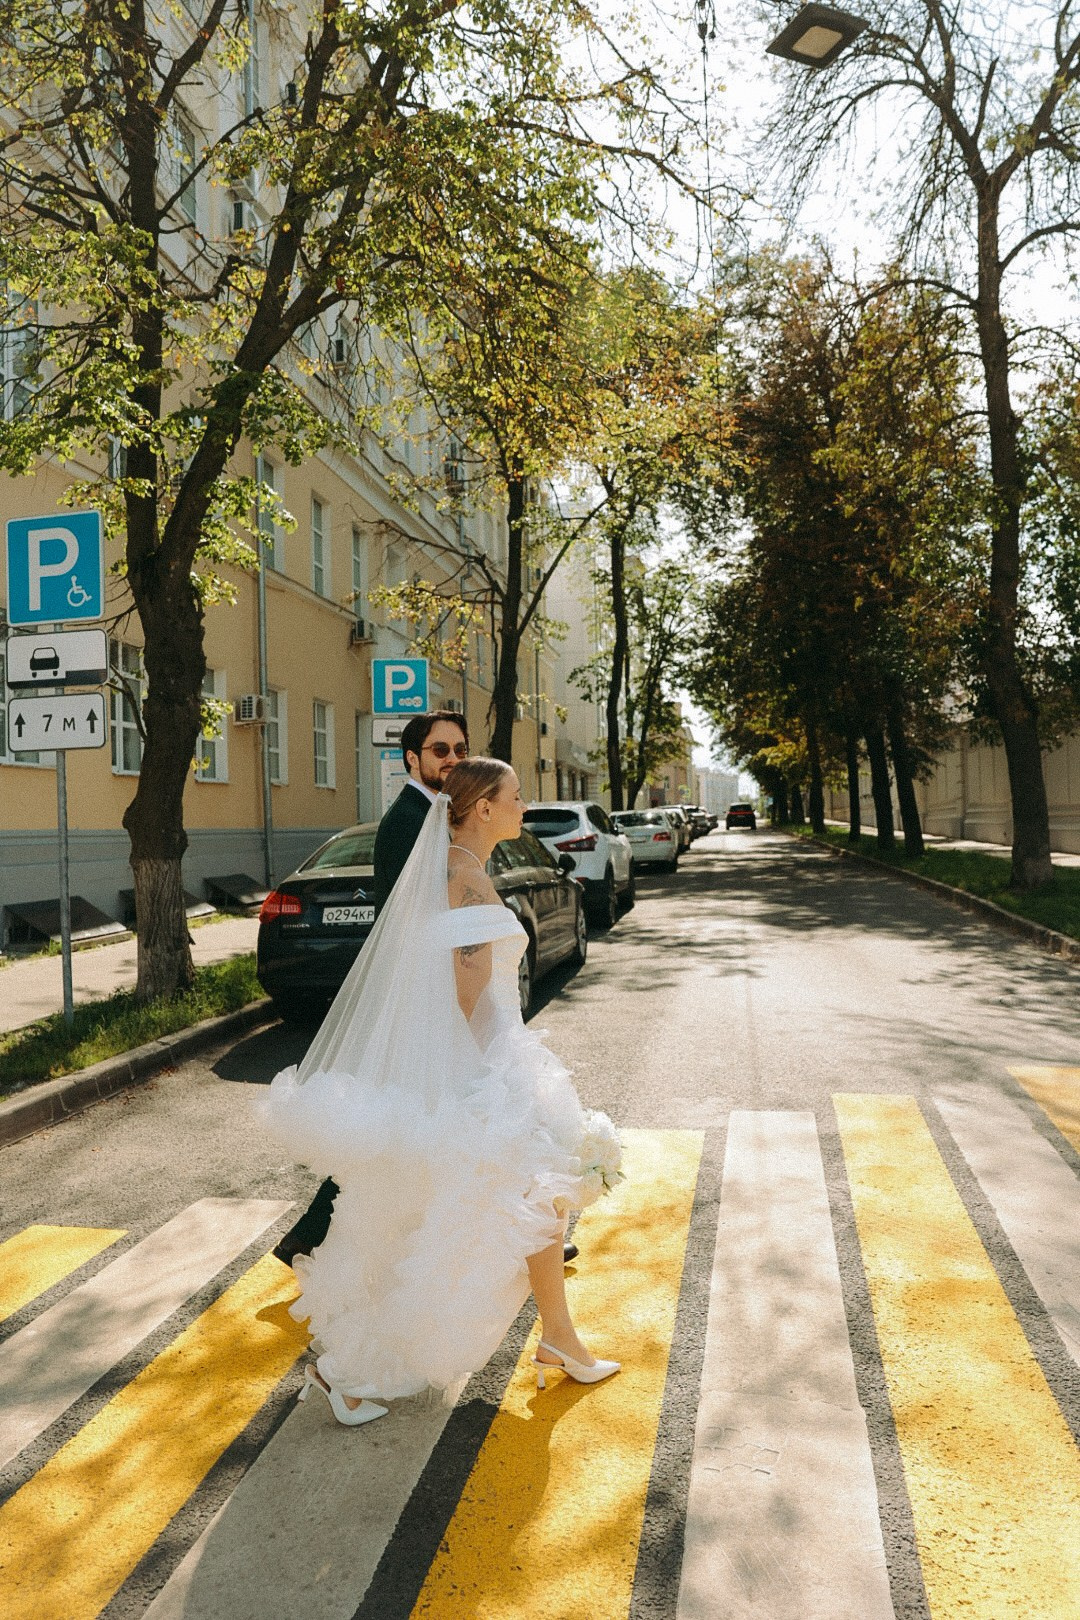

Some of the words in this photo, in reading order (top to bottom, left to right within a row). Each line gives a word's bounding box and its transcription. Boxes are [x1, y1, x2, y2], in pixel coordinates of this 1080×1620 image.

[28, 527, 80, 611] P
[385, 665, 415, 708] P
[42, 714, 53, 732] 7
